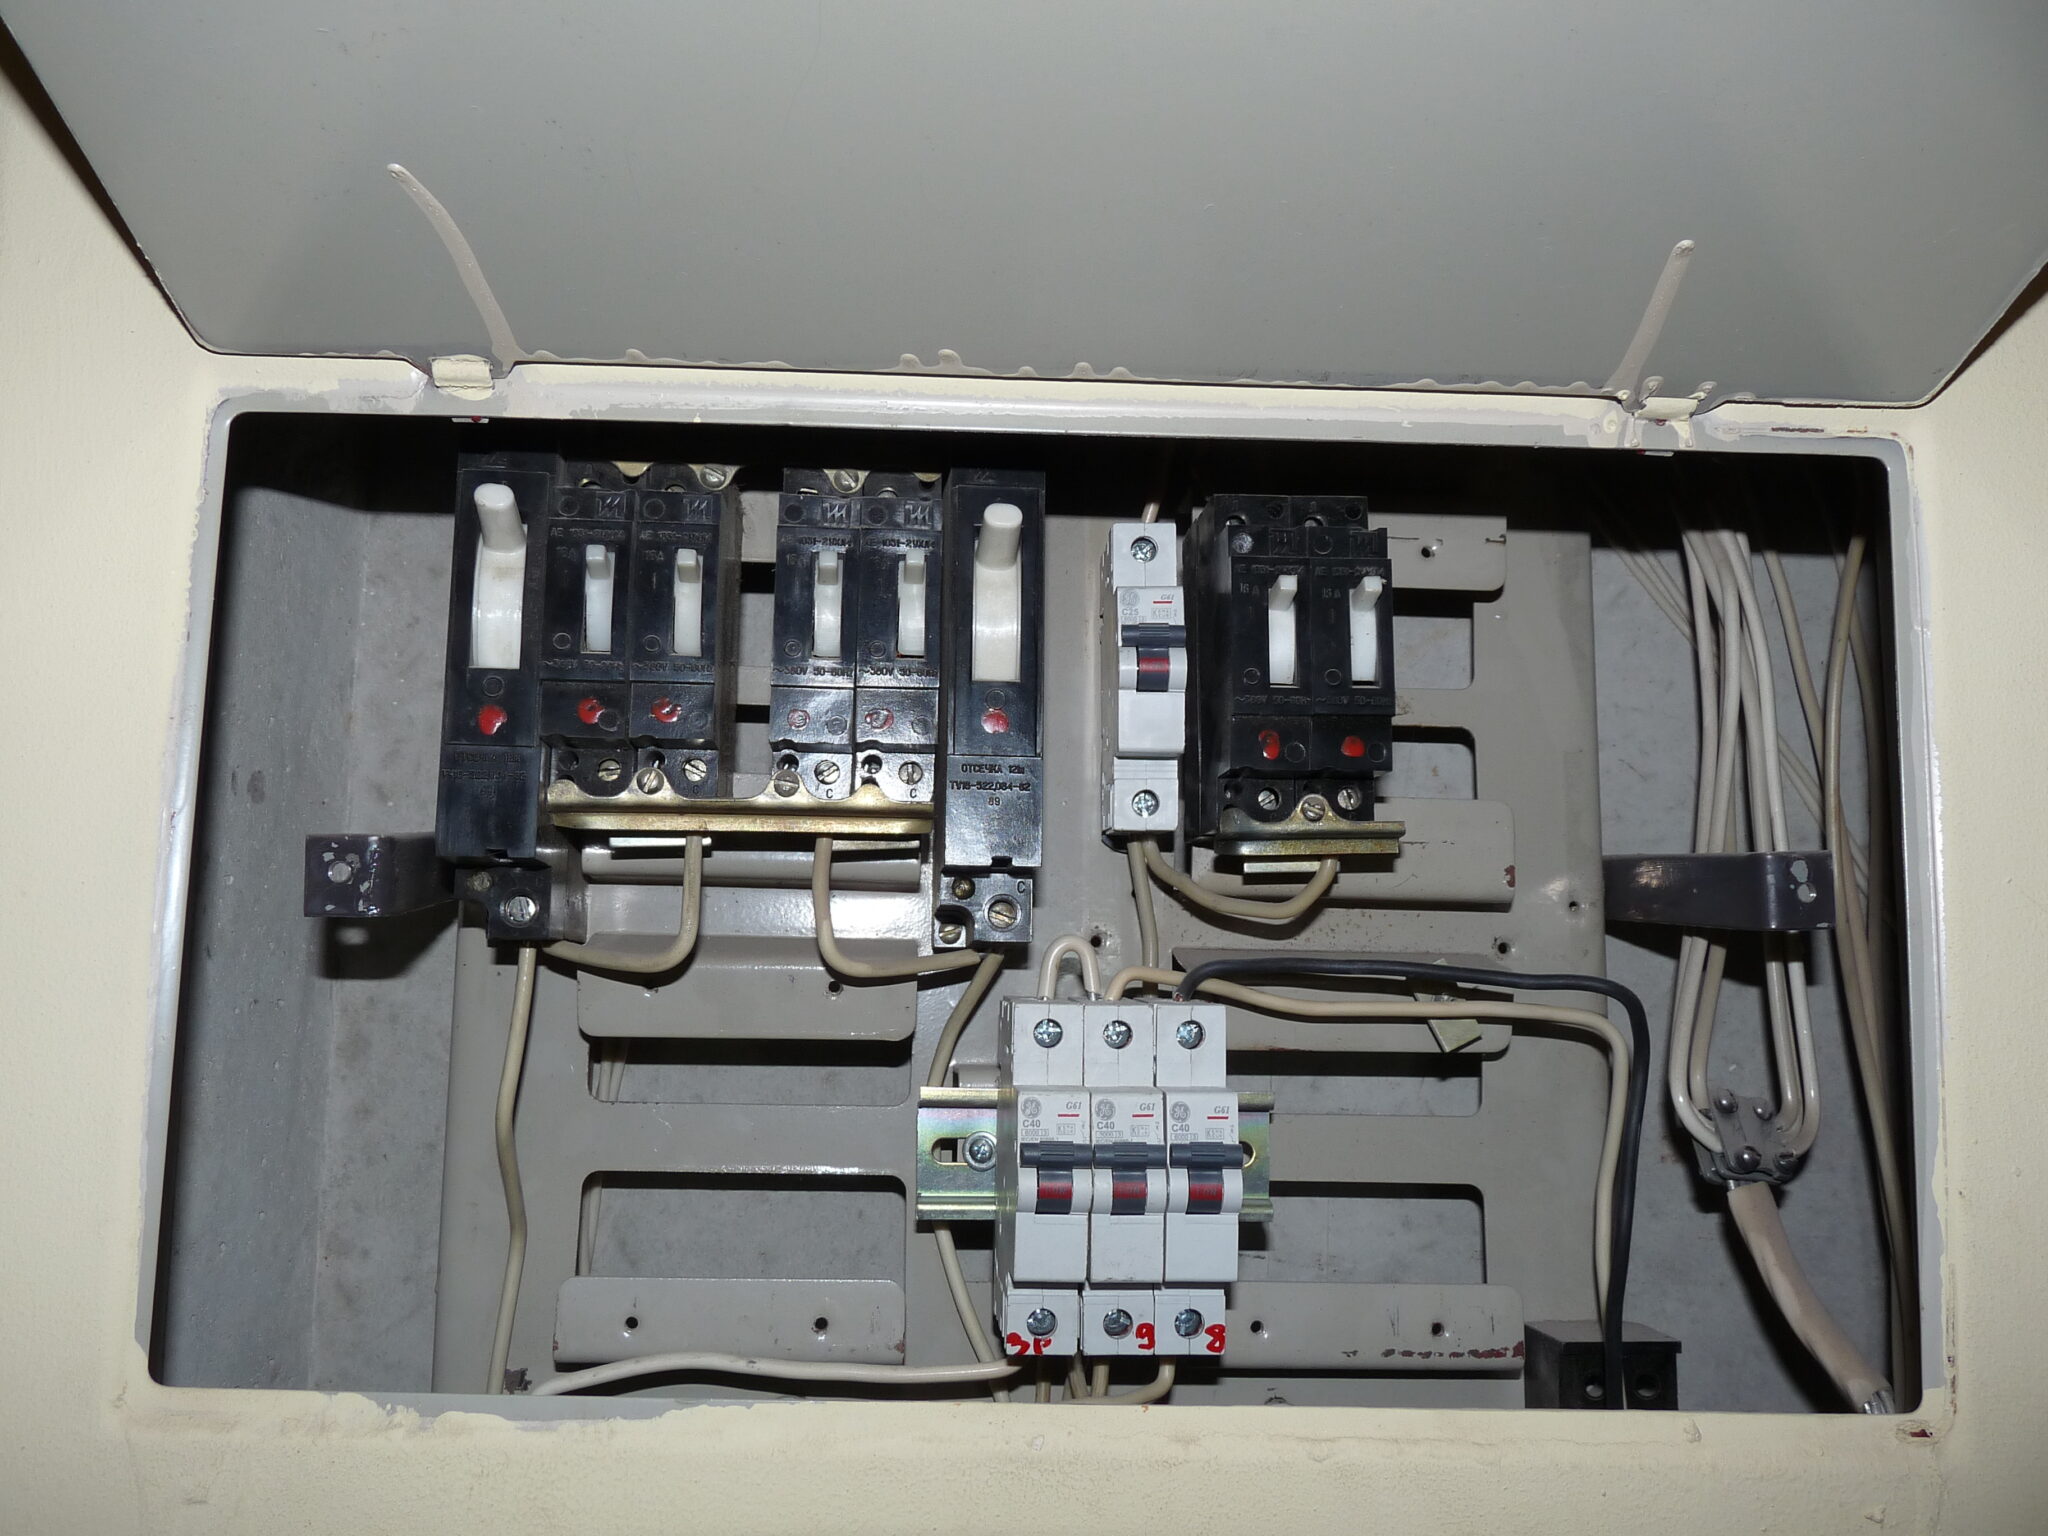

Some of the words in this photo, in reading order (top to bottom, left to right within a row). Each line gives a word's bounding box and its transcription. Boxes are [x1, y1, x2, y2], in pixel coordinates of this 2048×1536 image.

[1121, 608, 1140, 616] C25
[1065, 1101, 1082, 1111] G61
[1139, 1102, 1155, 1112] G61
[1214, 1105, 1230, 1115] G61
[1022, 1119, 1041, 1128] C40
[1096, 1121, 1115, 1130] C40
[1171, 1123, 1190, 1133] C40
